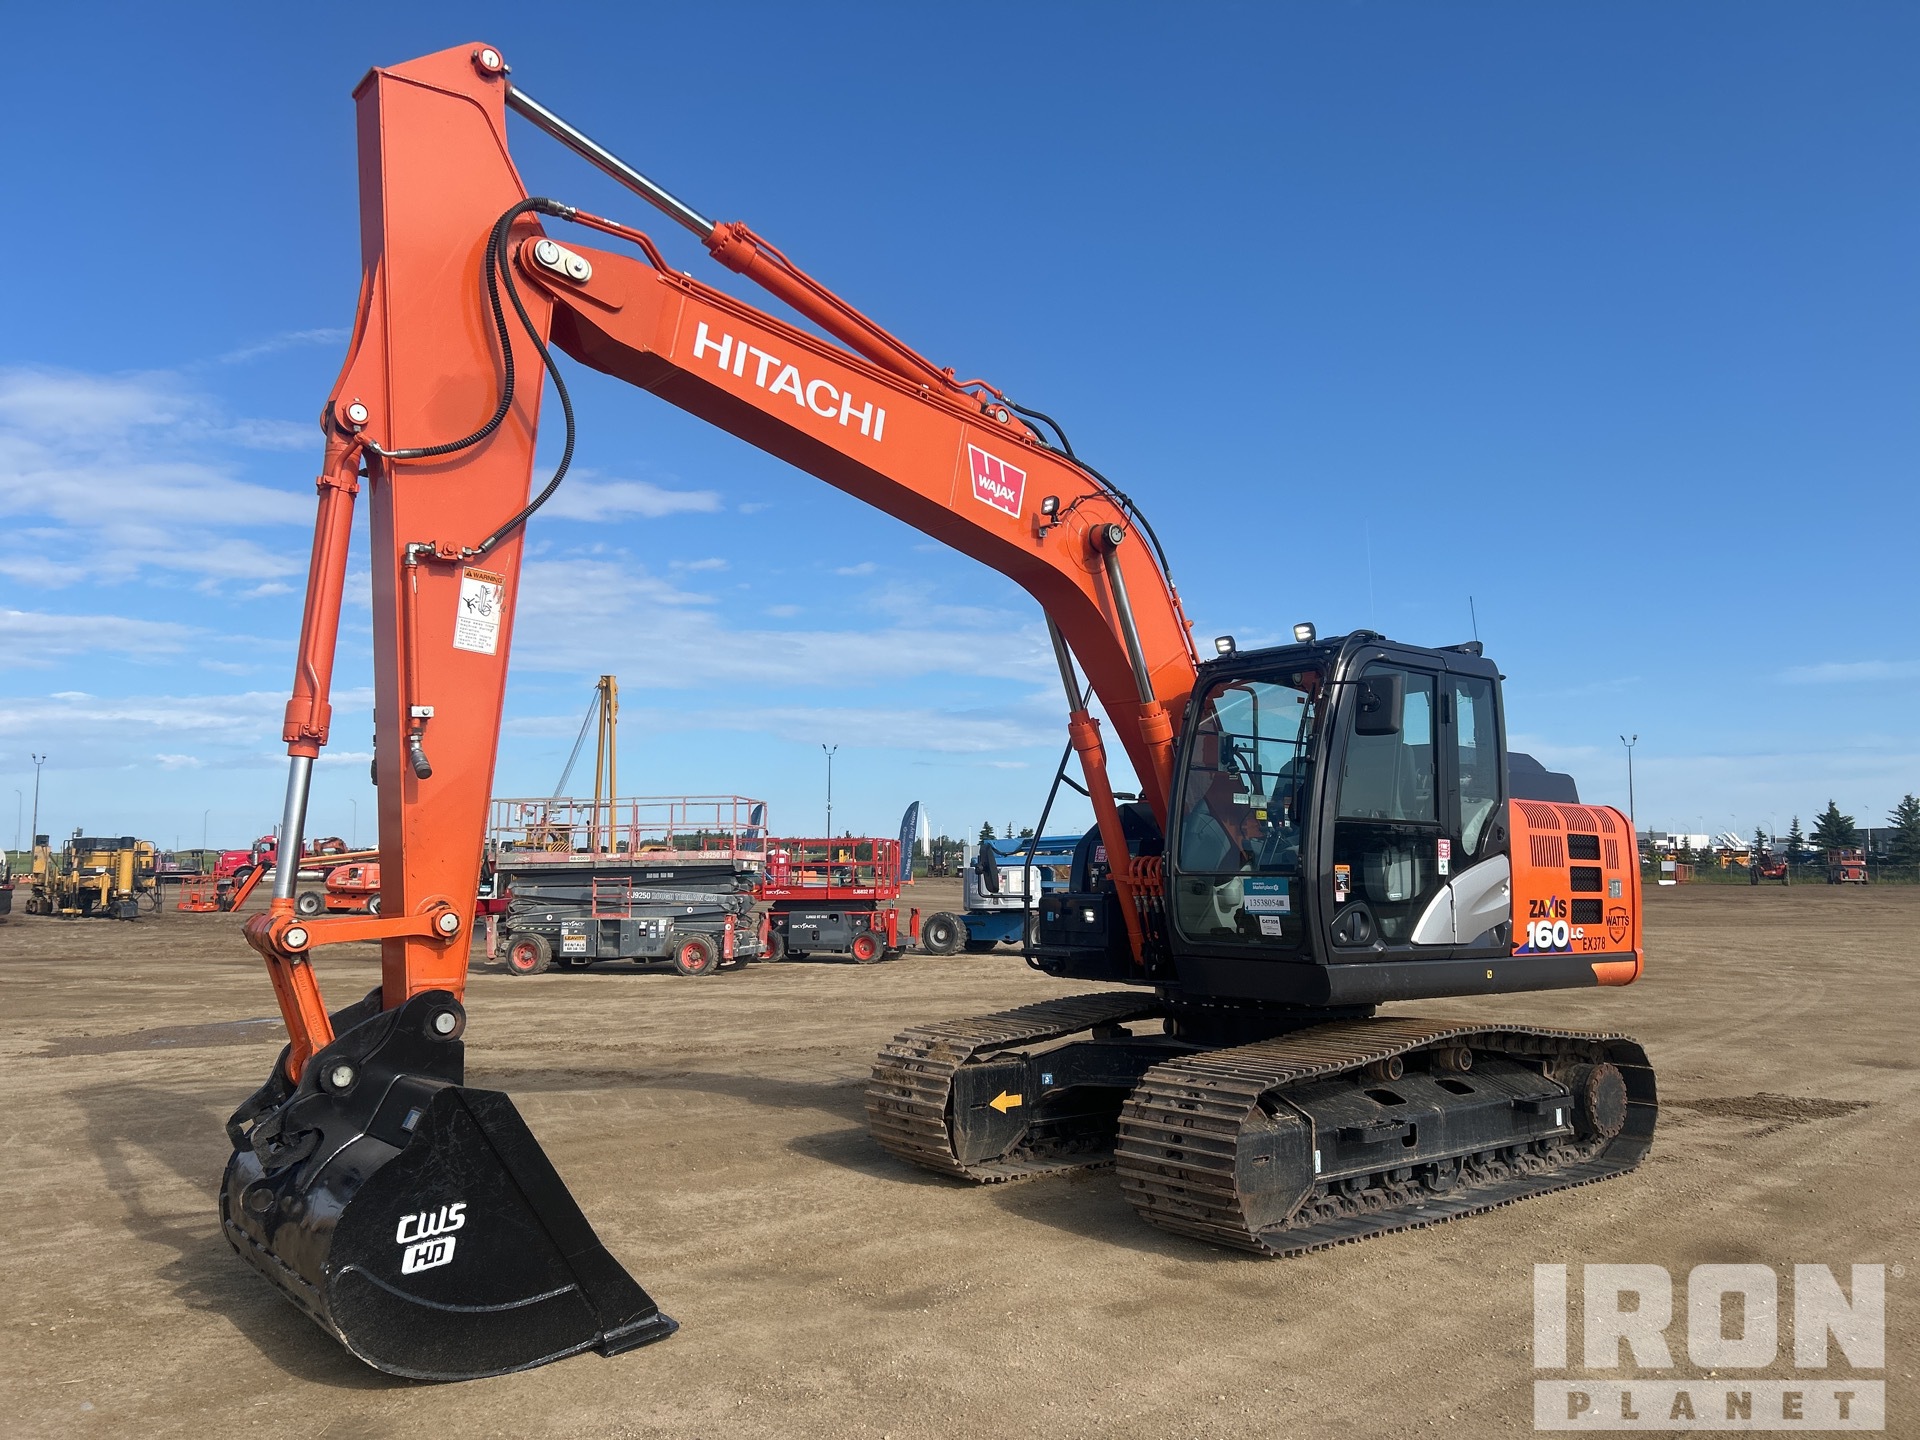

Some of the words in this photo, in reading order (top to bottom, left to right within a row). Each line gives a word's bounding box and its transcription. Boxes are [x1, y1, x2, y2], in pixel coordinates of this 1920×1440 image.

[693, 321, 886, 443] HITACHI
[978, 473, 1016, 503] WAJAX
[473, 572, 503, 584] WARNING
[698, 851, 720, 859] SJ9250
[627, 891, 651, 899] SJ9250
[1250, 898, 1280, 907] 13538054
[1529, 895, 1567, 918] ZAXIS
[792, 922, 818, 930] SKYJACK
[1605, 915, 1630, 926] WATTS
[1526, 920, 1569, 951] 160
[1570, 927, 1584, 940] LC
[1583, 936, 1606, 951] EX378
[396, 1203, 467, 1244] CWS
[412, 1241, 447, 1269] HD
